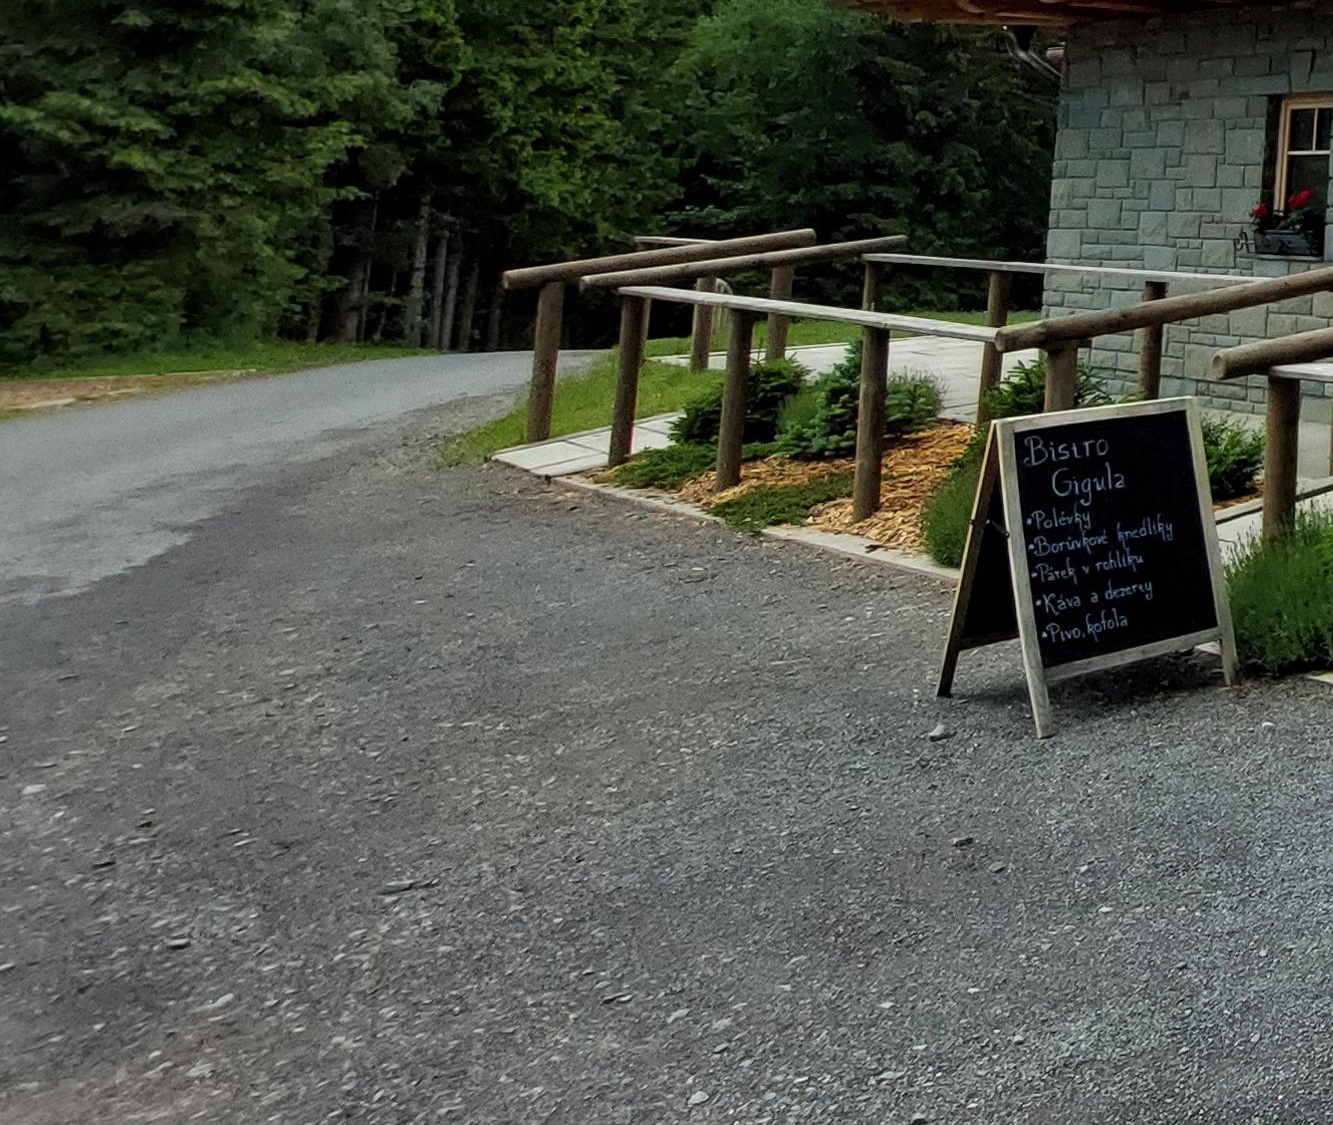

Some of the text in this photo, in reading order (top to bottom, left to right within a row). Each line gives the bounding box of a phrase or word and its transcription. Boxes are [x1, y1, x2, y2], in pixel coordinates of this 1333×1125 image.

[1023, 435, 1109, 467] Bistro
[1052, 462, 1126, 506] Gigula
[1031, 502, 1092, 531] Polévky
[1082, 565, 1090, 574] v
[1090, 591, 1099, 604] a
[1104, 579, 1153, 601] dezerty
